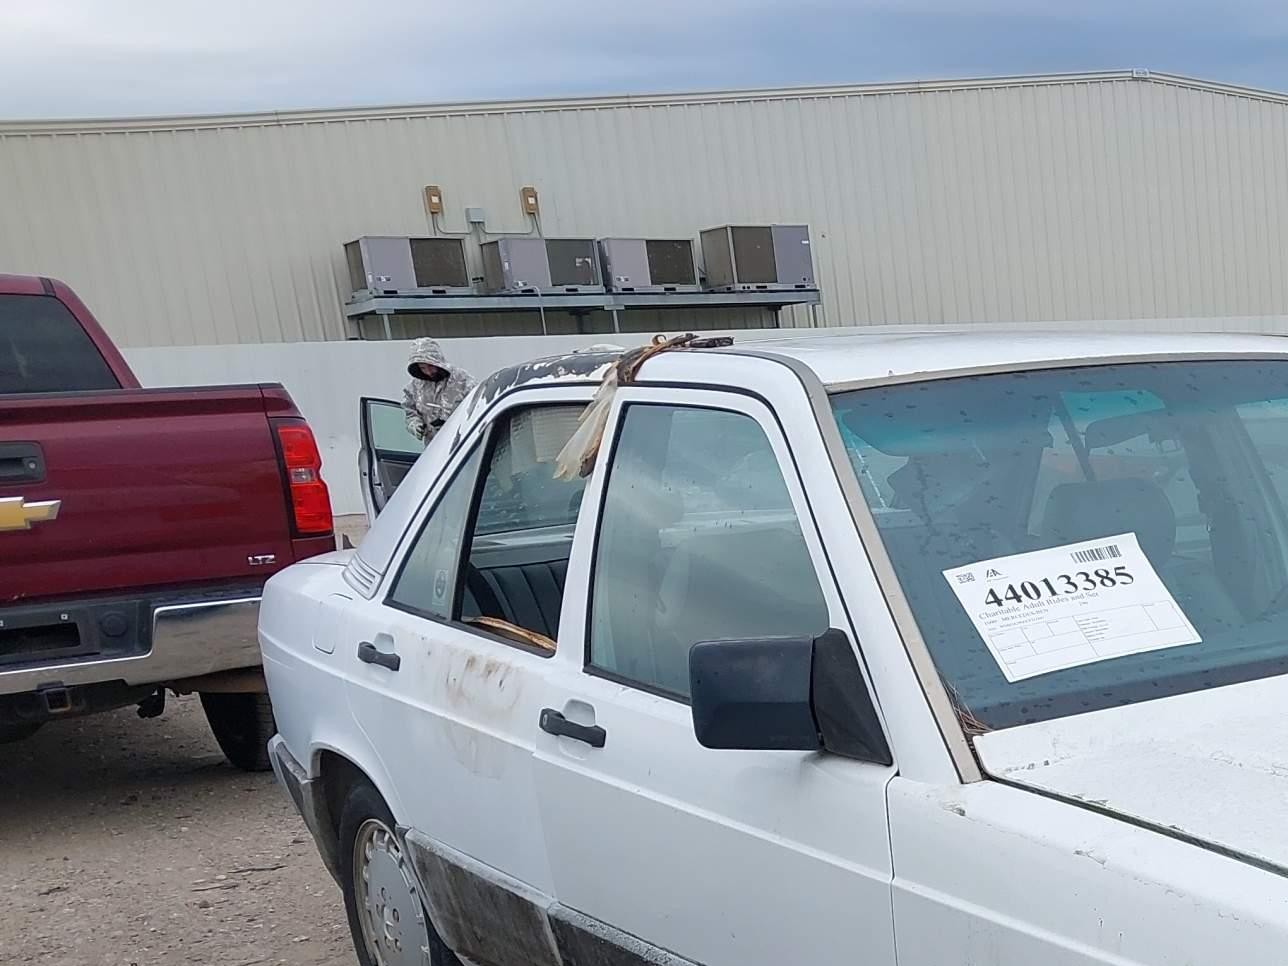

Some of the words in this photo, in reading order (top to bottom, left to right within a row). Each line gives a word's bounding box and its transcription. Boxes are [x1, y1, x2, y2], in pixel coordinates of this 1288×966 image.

[248, 554, 276, 566] LTZ
[984, 565, 1135, 608] 44013385
[978, 606, 1021, 620] Charitable
[1023, 600, 1046, 610] Adult
